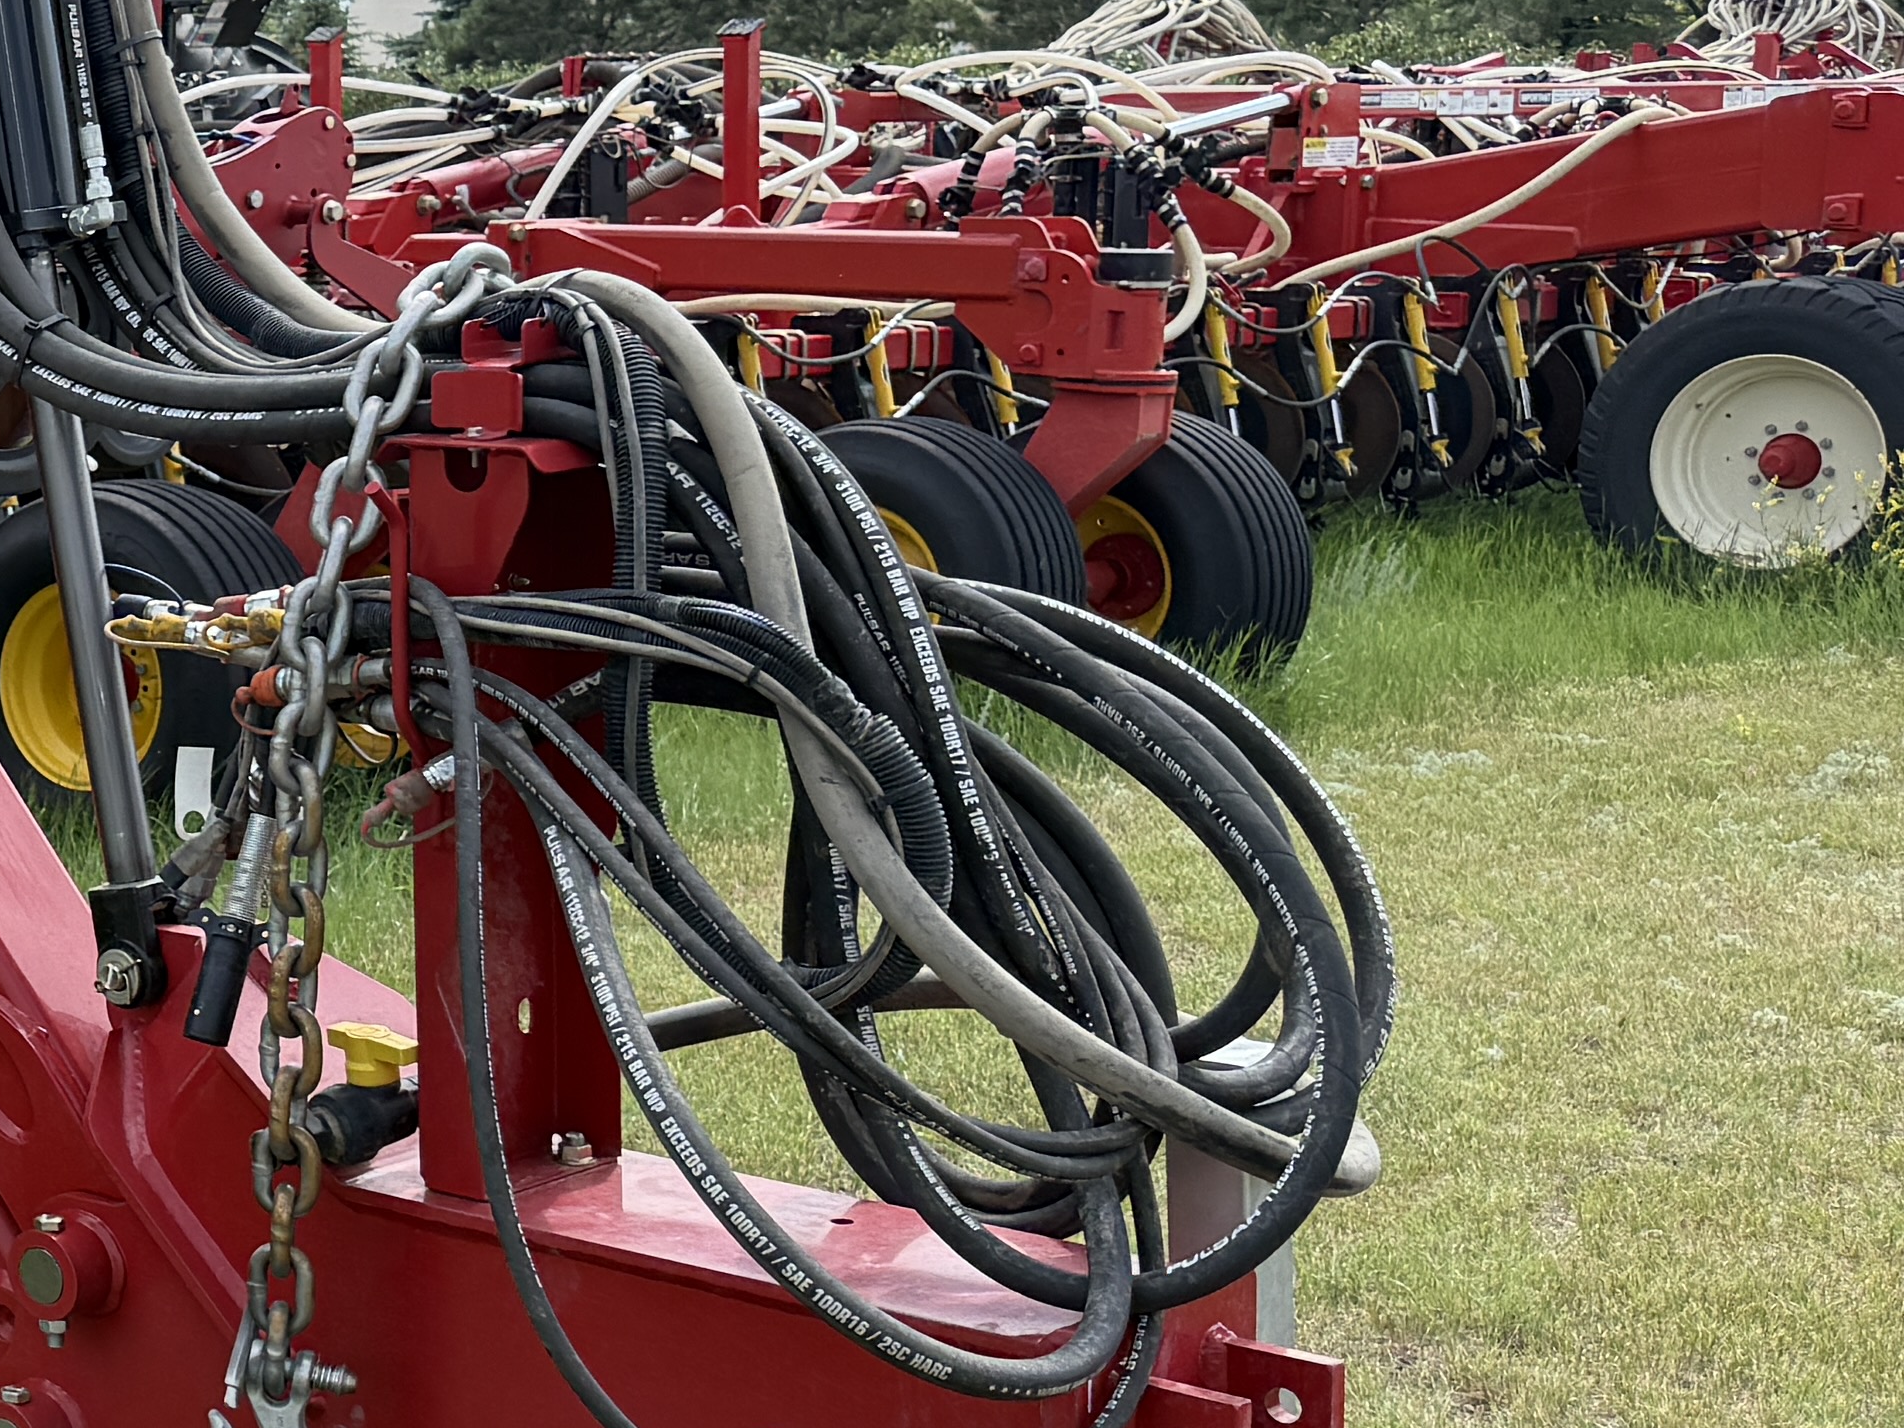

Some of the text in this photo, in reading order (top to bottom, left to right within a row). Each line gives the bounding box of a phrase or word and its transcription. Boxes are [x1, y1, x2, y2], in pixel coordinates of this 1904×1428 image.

[68, 4, 83, 58] PULSAR
[92, 264, 110, 282] 215
[812, 452, 842, 475] 3/4"
[836, 480, 866, 512] 3100
[856, 511, 880, 534] PSI
[873, 539, 898, 568] 215
[886, 569, 910, 596] BAR
[854, 592, 891, 652] PULSAR
[898, 596, 920, 621] WP
[909, 626, 941, 683] EXCEEDS
[929, 685, 951, 712] SAE
[938, 714, 968, 765] 100R17
[958, 779, 980, 806] SAE
[544, 824, 574, 892] PULSAR
[564, 892, 591, 942] 112CC-12
[839, 904, 854, 934] SAE
[581, 943, 600, 966] 3/4"
[590, 972, 614, 1005] 3100
[603, 1003, 623, 1026] PSI
[616, 1034, 637, 1060] 215
[628, 1059, 653, 1090] BAR
[643, 1084, 667, 1113] WP
[660, 1116, 707, 1178] EXCEEDS
[701, 1175, 729, 1205] SAE
[725, 1203, 777, 1256] 100R17
[781, 1263, 813, 1293] SAE
[811, 1288, 870, 1336] 100R16
[877, 1336, 912, 1361] 2SC
[1126, 1315, 1148, 1371] PULSAR
[909, 1352, 952, 1381] HARC
